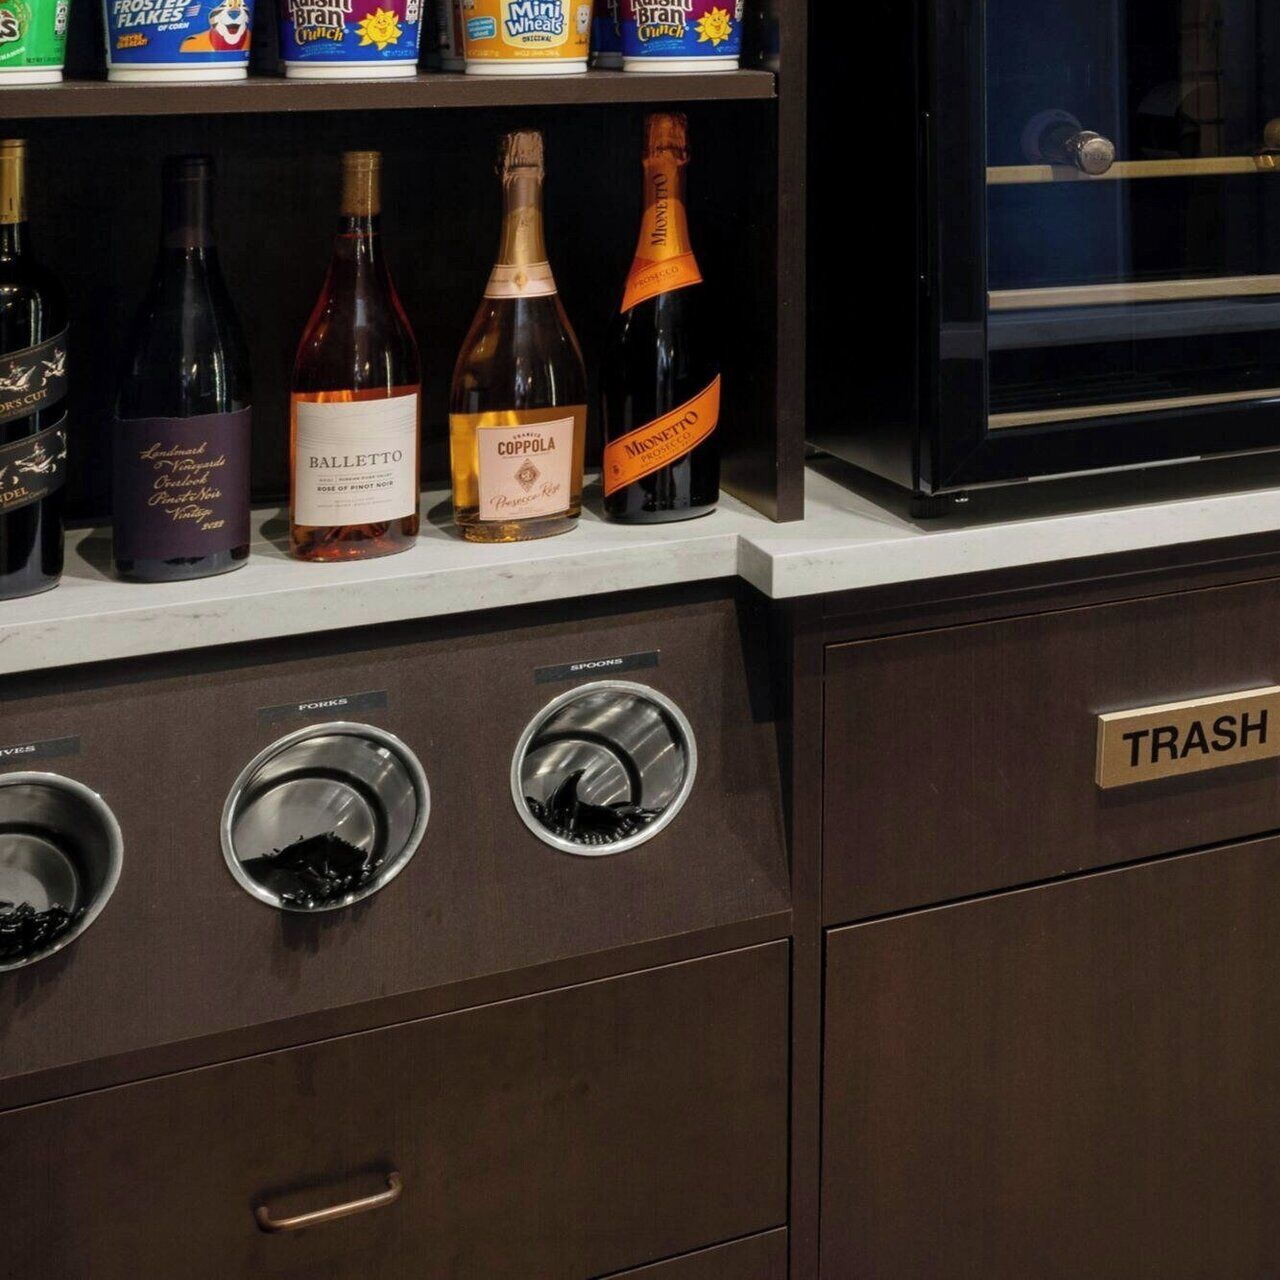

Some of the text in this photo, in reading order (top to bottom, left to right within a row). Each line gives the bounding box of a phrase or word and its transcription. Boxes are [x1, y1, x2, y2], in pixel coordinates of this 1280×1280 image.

[116, 9, 185, 29] FLAKES
[509, 0, 562, 19] Mini
[637, 6, 686, 26] Bran
[505, 17, 563, 36] Wheats
[637, 24, 685, 41] Crunch
[24, 389, 48, 404] CUT
[140, 442, 208, 461] Landmark
[497, 436, 556, 456] COPPOLA
[640, 431, 693, 465] PROSECCO
[309, 450, 402, 469] BALLETTO
[153, 473, 208, 490] Overlook
[350, 480, 394, 491] PINOT NOIR
[148, 489, 190, 507] Pinot
[489, 491, 538, 511] Prosecco
[164, 506, 213, 524] Vintage
[200, 519, 226, 531] 2022
[569, 657, 625, 673] SPOONS
[298, 696, 349, 713] FORKS
[1122, 709, 1269, 767] TRASH
